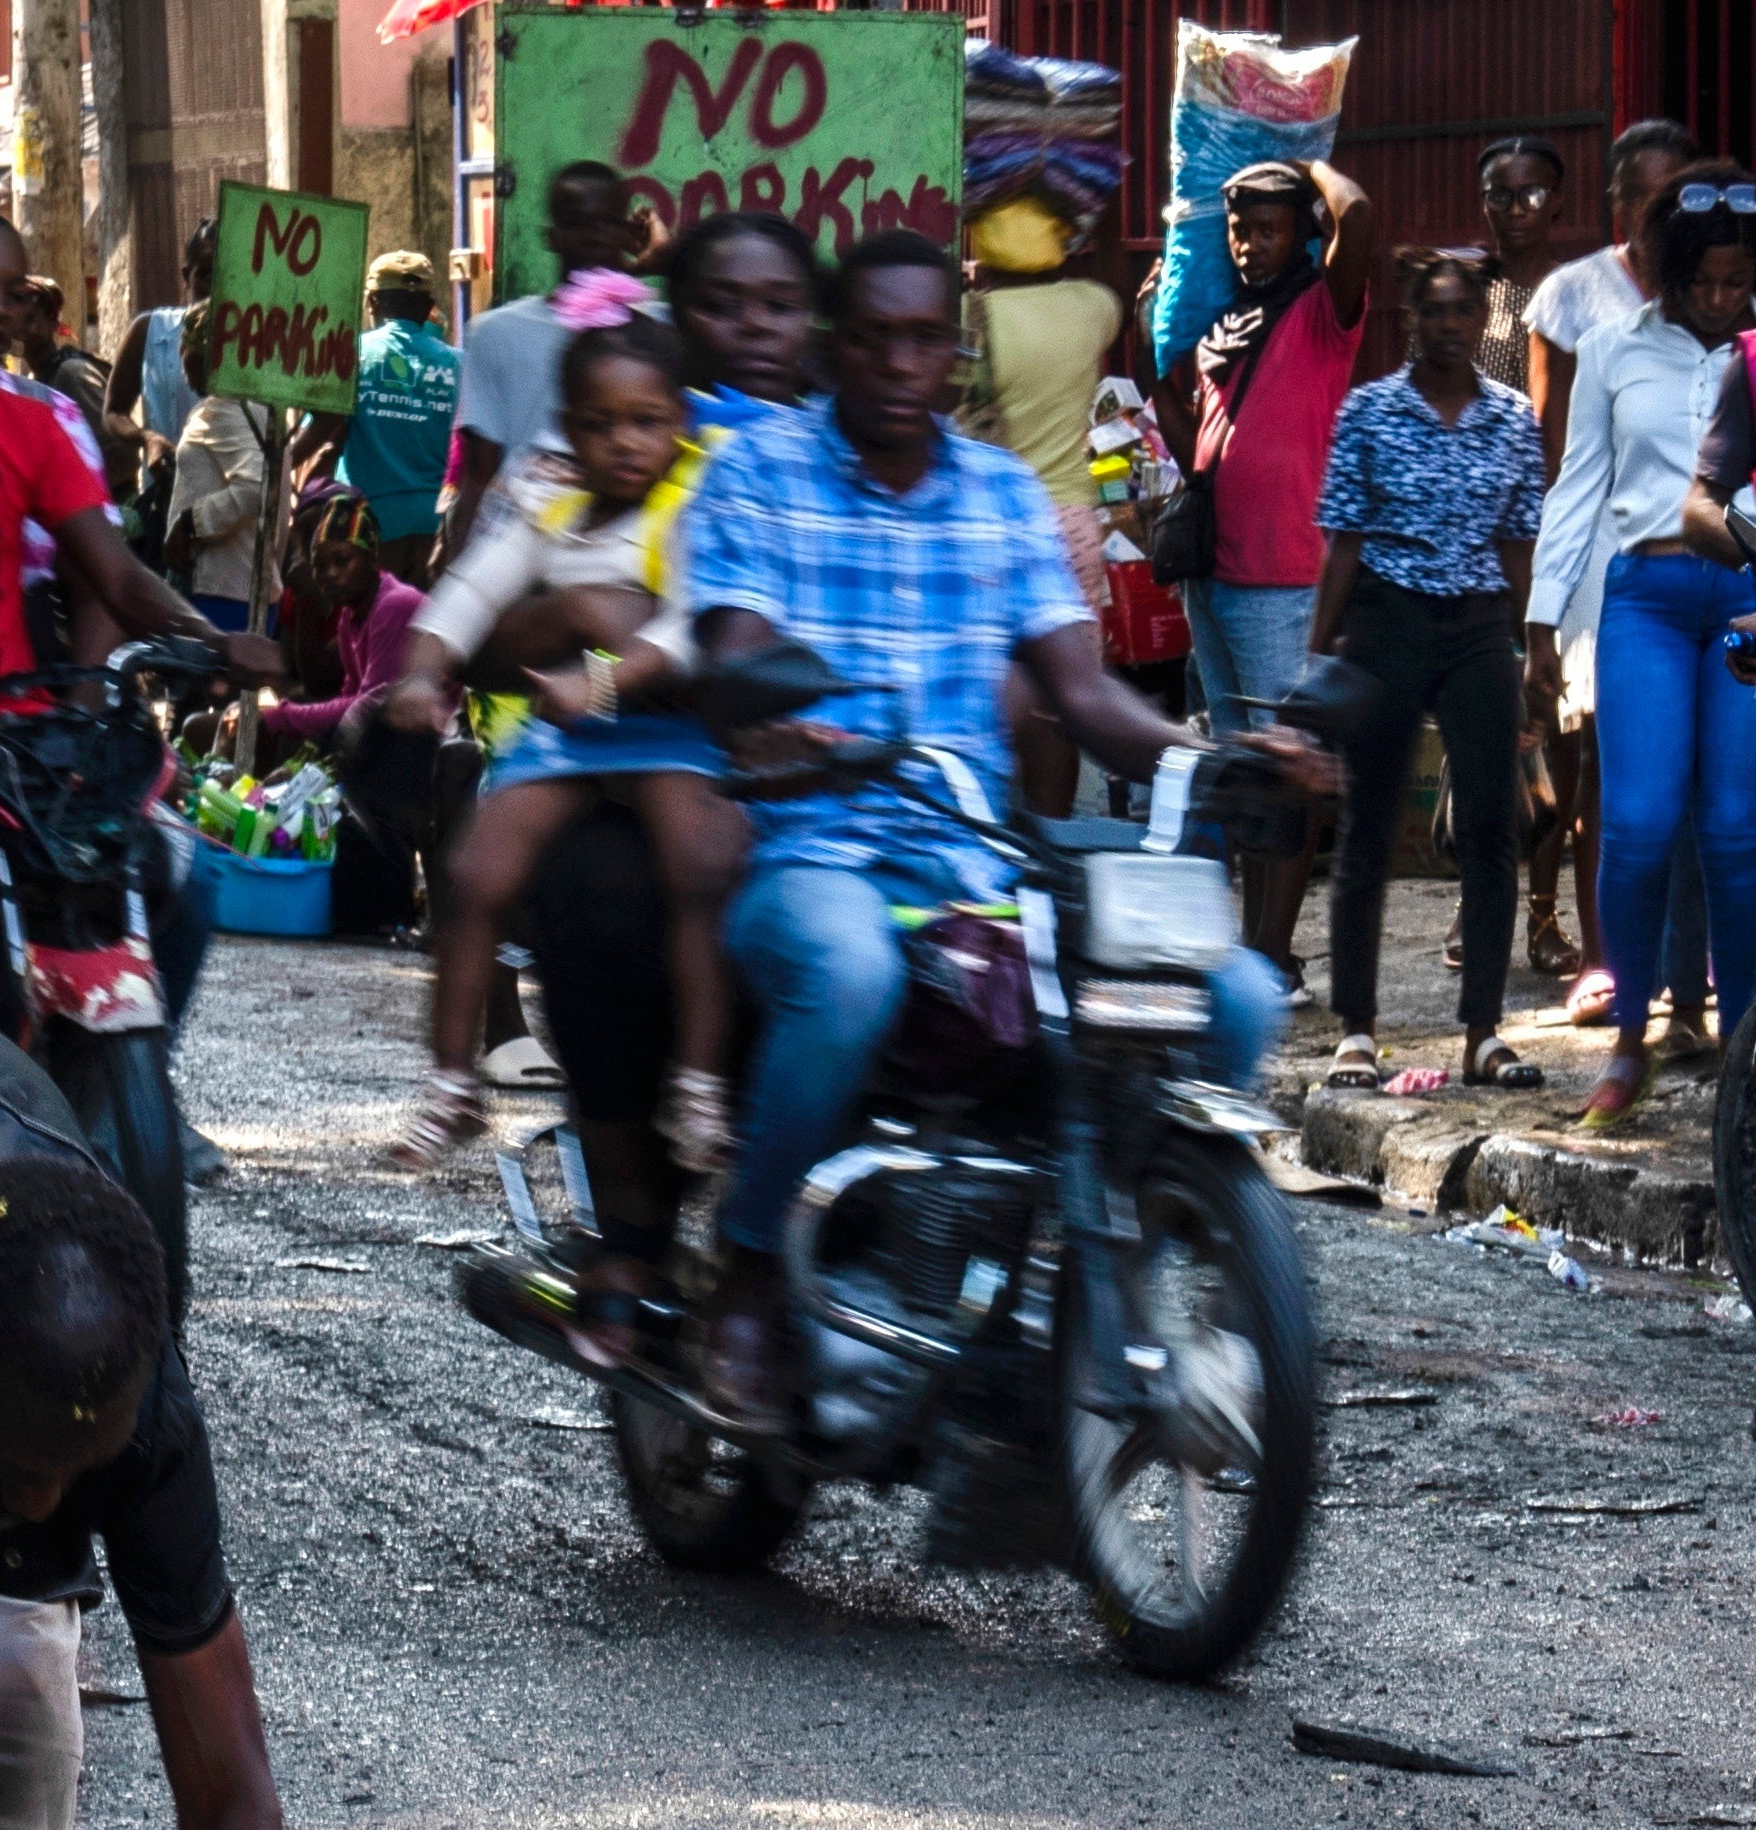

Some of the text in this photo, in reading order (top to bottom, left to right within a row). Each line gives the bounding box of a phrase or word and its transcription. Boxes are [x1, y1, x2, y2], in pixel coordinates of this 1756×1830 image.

[617, 36, 828, 168] NO
[251, 201, 322, 277] NO
[358, 390, 453, 413] yTennis.net
